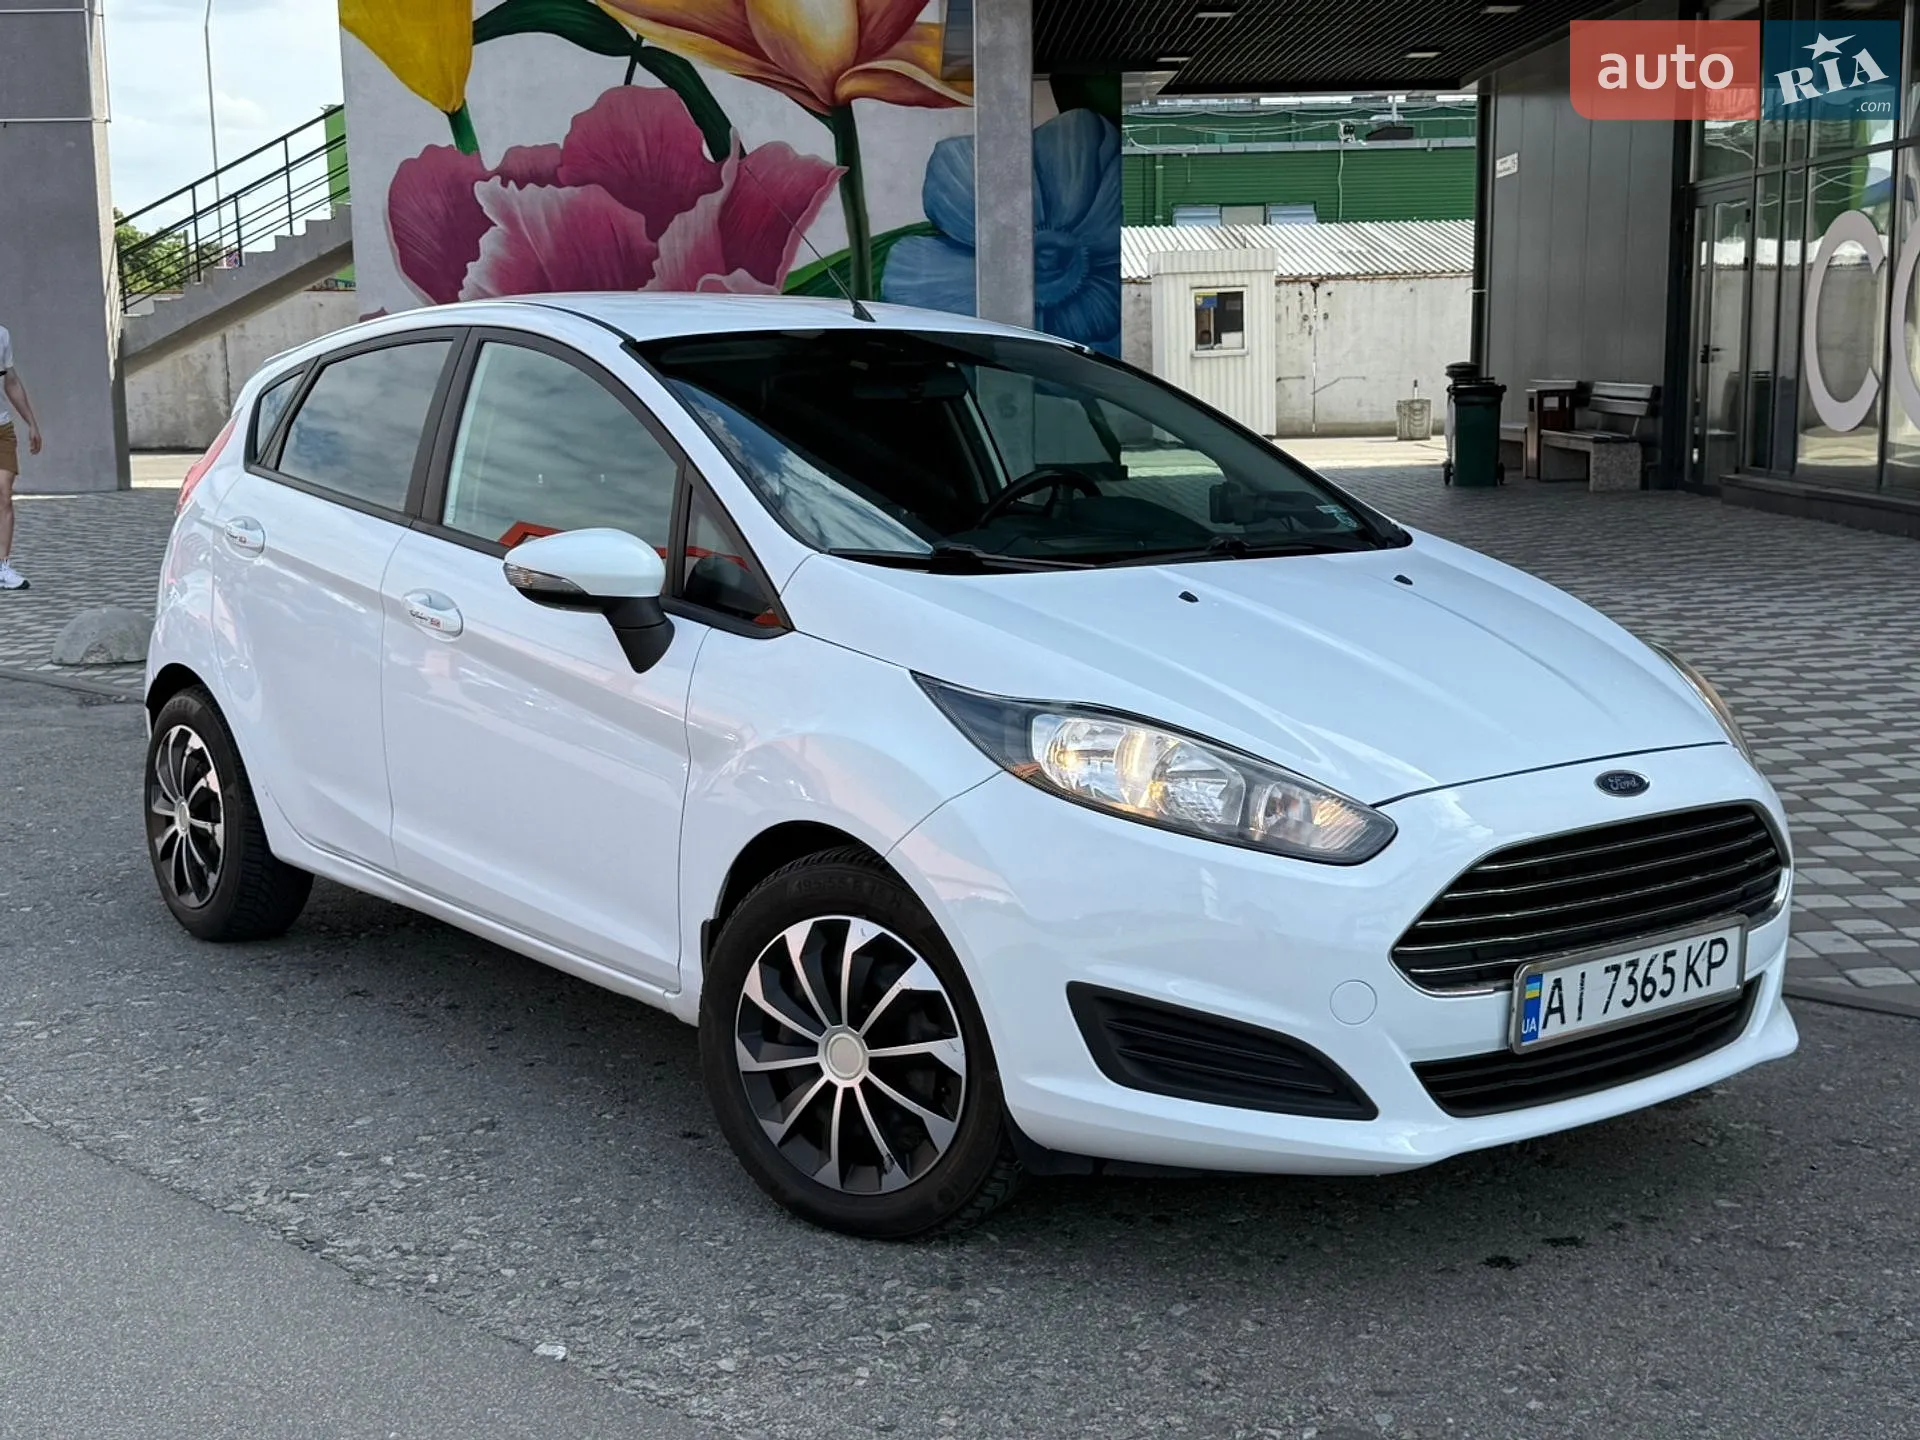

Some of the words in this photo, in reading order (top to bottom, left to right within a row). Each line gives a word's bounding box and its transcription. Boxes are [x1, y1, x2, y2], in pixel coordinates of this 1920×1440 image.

[1542, 971, 1587, 1030] AI
[1602, 949, 1678, 1015] 7365
[1682, 936, 1729, 993] KP
[1522, 1016, 1538, 1034] UA
